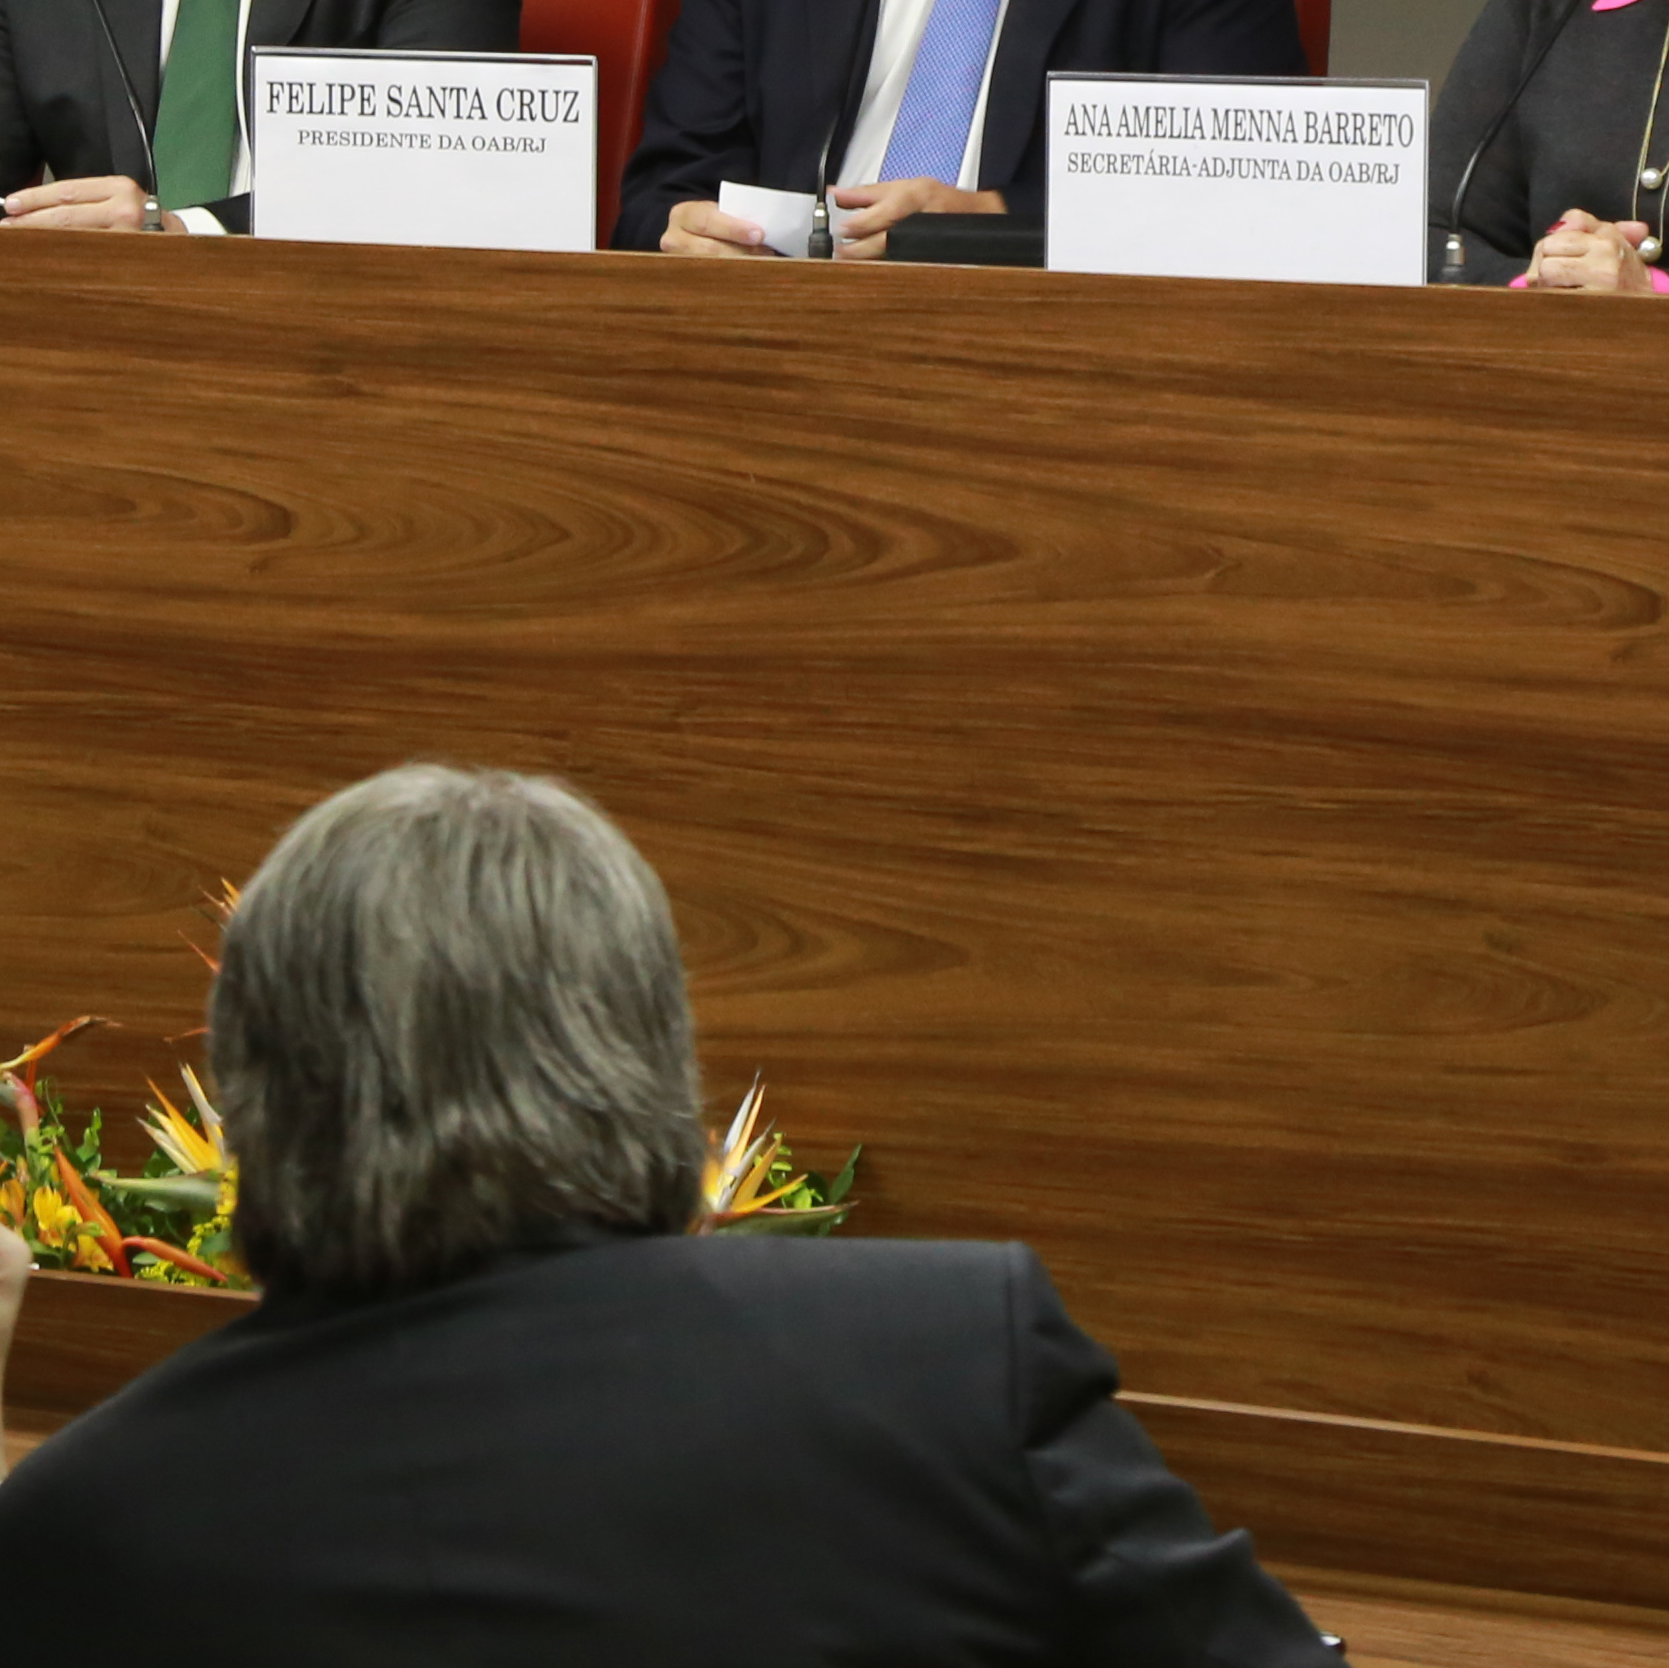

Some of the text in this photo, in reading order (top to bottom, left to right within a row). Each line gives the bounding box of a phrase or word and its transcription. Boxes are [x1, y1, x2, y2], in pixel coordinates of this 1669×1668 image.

[266, 81, 580, 123] FELIPE SANTA CRUZ
[298, 130, 547, 154] PRESIDENTE DA OAB/RJ
[1064, 104, 1414, 149] ANA AMELIA MENNA BARRETO
[1067, 149, 1400, 184] SECRETÁRIA-ADJUNTA DA OAB/RJ
